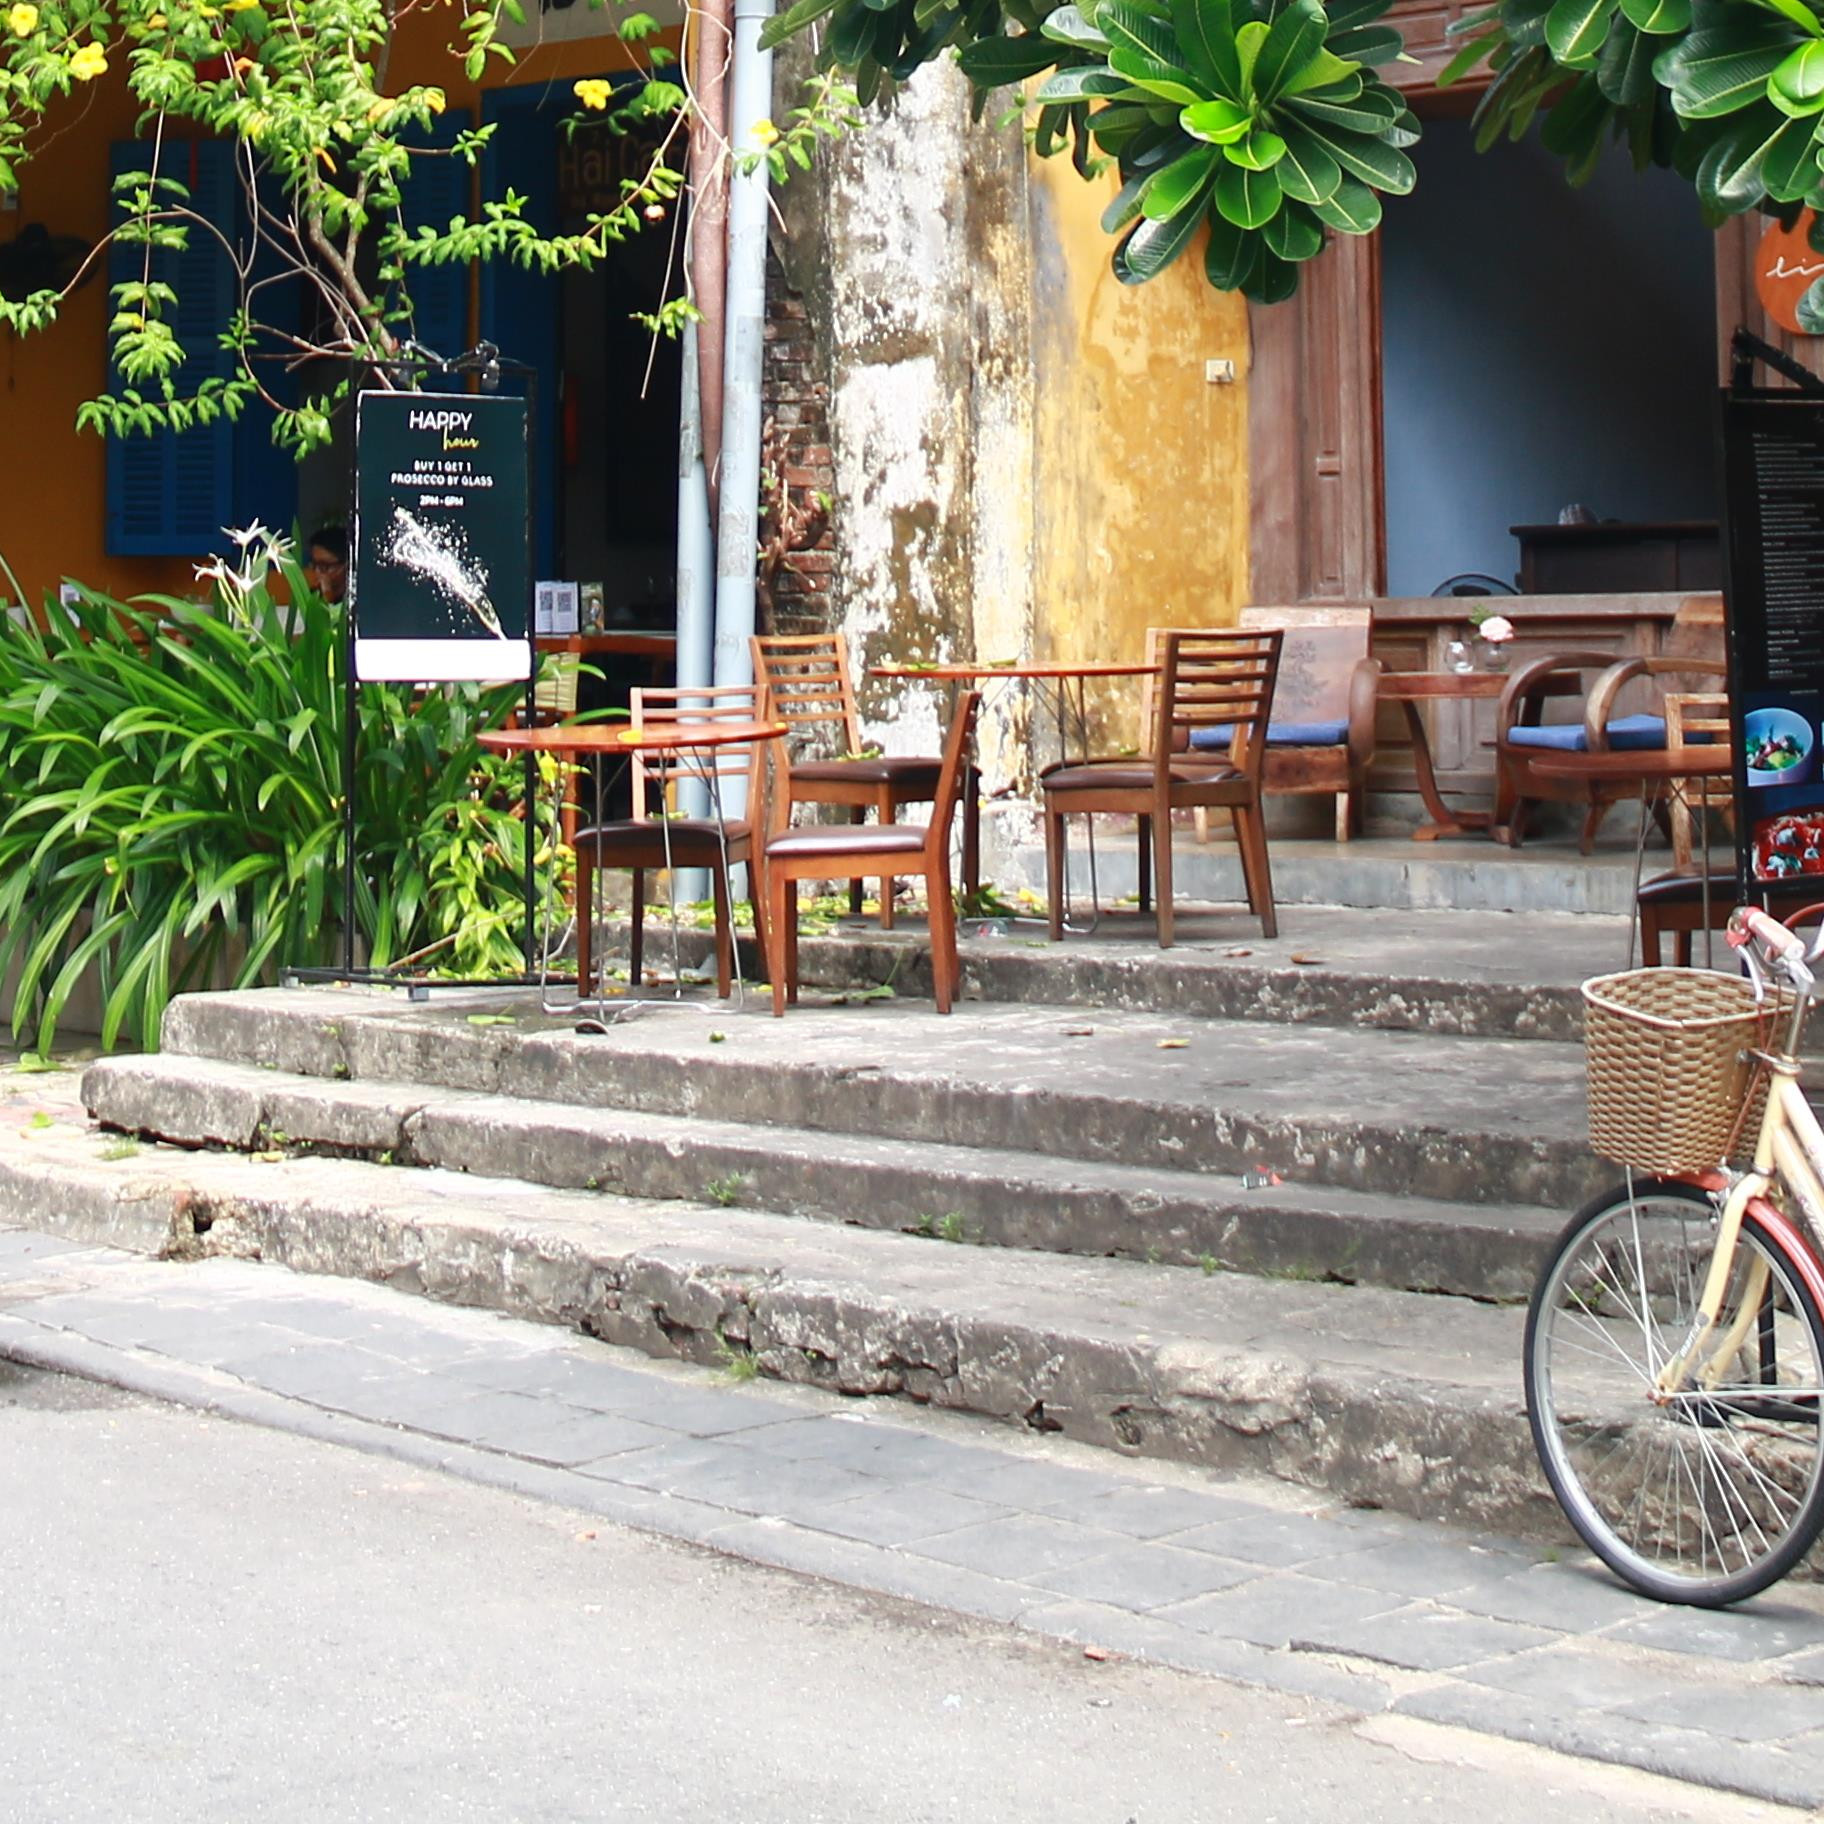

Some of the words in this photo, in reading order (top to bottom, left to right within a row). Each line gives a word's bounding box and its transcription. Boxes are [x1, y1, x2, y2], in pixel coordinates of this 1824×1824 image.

[409, 409, 473, 432] HAPPY
[443, 425, 479, 451] hour
[414, 460, 434, 472] BUY
[444, 461, 464, 472] GET
[391, 472, 445, 486] PROSECCO
[447, 474, 460, 487] BY
[461, 475, 494, 488] GLASS
